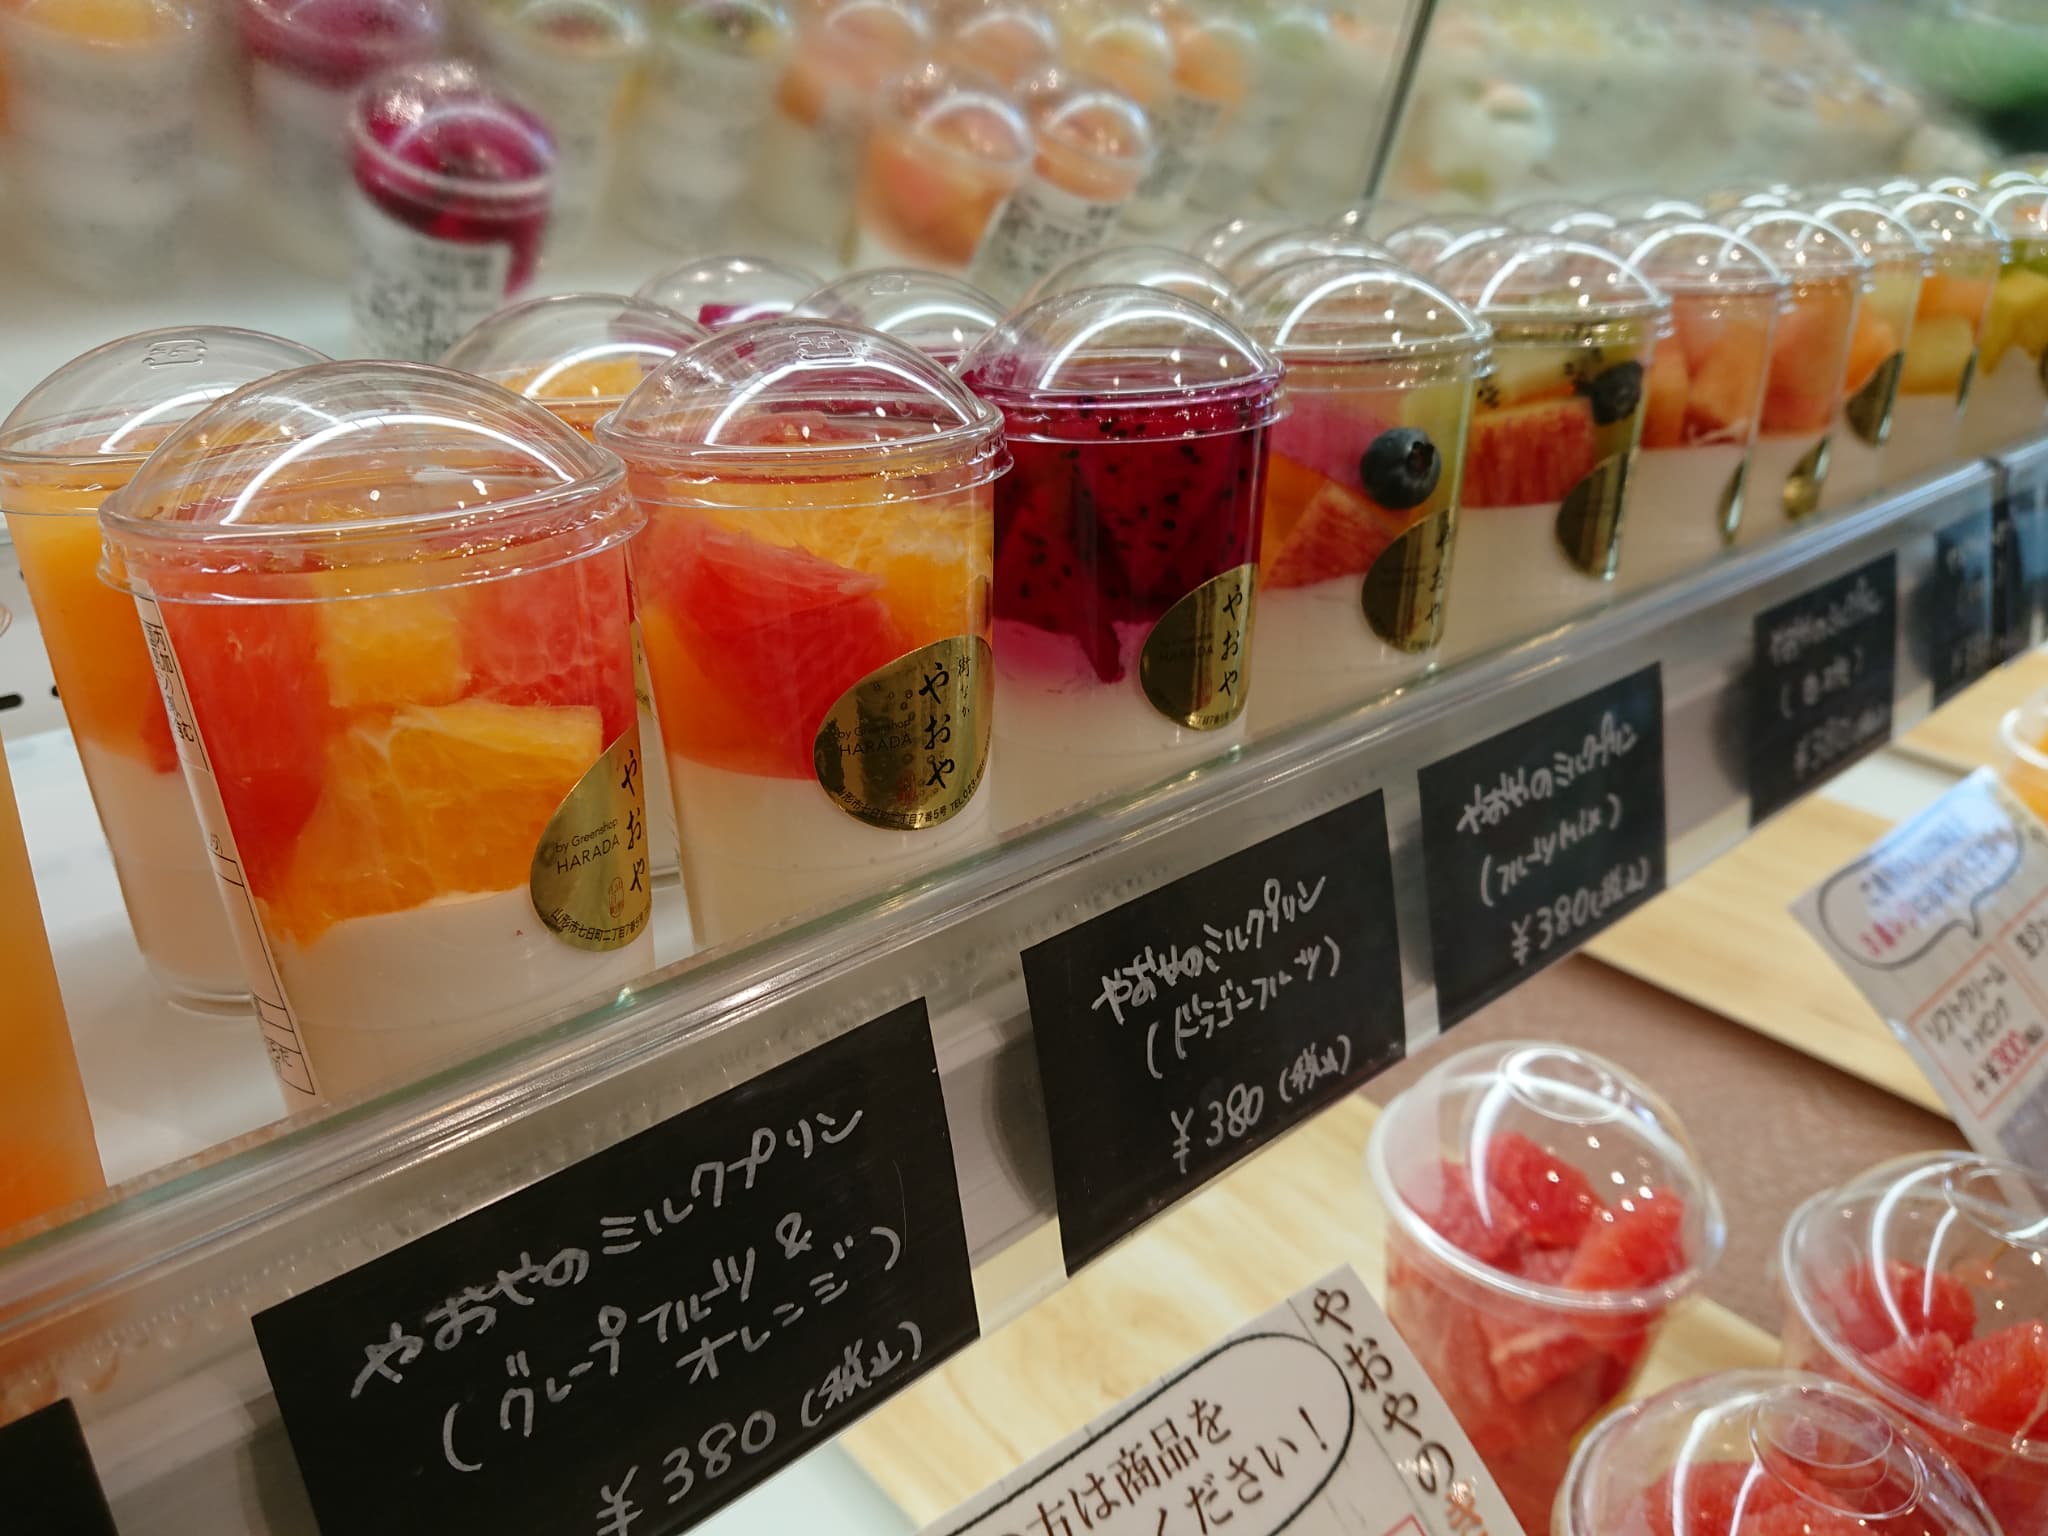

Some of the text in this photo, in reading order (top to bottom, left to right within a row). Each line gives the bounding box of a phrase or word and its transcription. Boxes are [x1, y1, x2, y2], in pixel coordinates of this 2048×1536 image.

[1218, 583, 1243, 696] やおや
[840, 733, 912, 756] HARADA
[919, 662, 955, 789] やおや
[555, 819, 618, 854] by Greenshop
[557, 833, 620, 874] HARADA
[621, 749, 646, 893] やおや
[1091, 876, 1327, 1024] やおやのミルクプリン
[1147, 935, 1341, 1080] (ドラゴンフルーツ)
[350, 1110, 863, 1399] やおやのミルクプリン
[1001, 1398, 1232, 1536] 方は商品を
